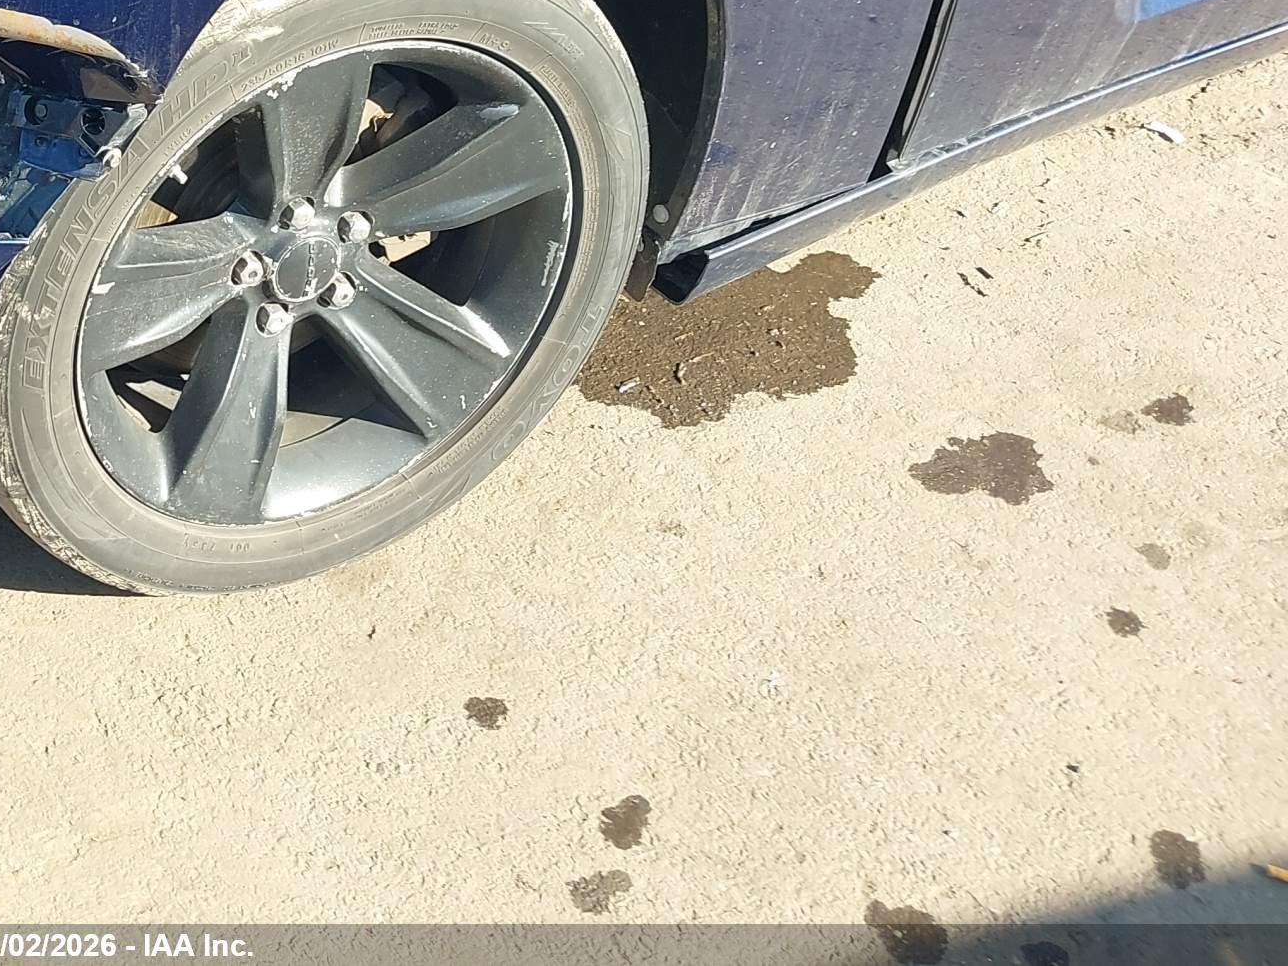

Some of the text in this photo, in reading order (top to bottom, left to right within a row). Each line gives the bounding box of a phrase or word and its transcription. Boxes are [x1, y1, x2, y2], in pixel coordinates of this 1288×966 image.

[21, 137, 153, 391] EXTENSA
[158, 64, 232, 136] HP
[492, 305, 608, 462] TOYO
